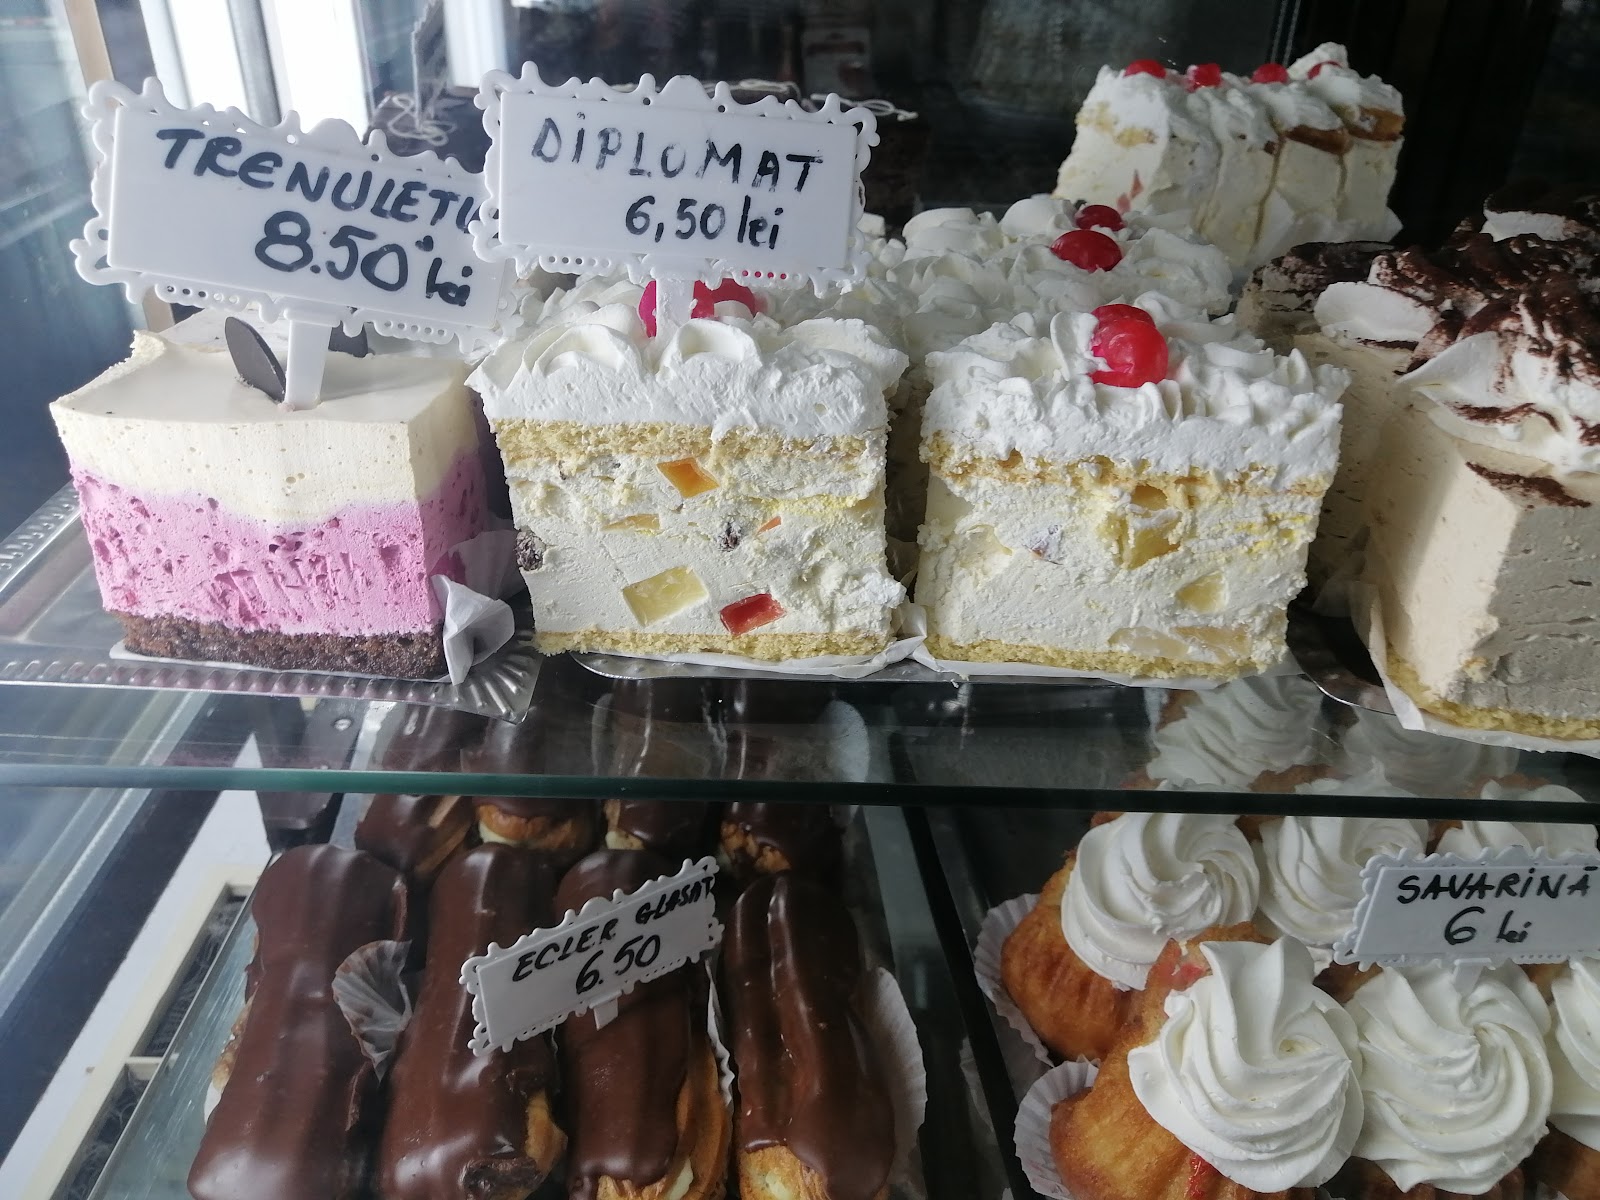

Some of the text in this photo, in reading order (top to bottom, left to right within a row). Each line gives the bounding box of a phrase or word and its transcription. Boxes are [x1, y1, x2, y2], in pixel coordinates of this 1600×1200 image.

[531, 111, 824, 193] DIPLOMAT
[625, 194, 784, 250] 6,50 lei
[254, 210, 473, 307] 8.50 lei
[512, 876, 714, 983] ECLER GLASAT
[1444, 906, 1532, 945] 6 lei
[575, 934, 661, 995] 6.50
